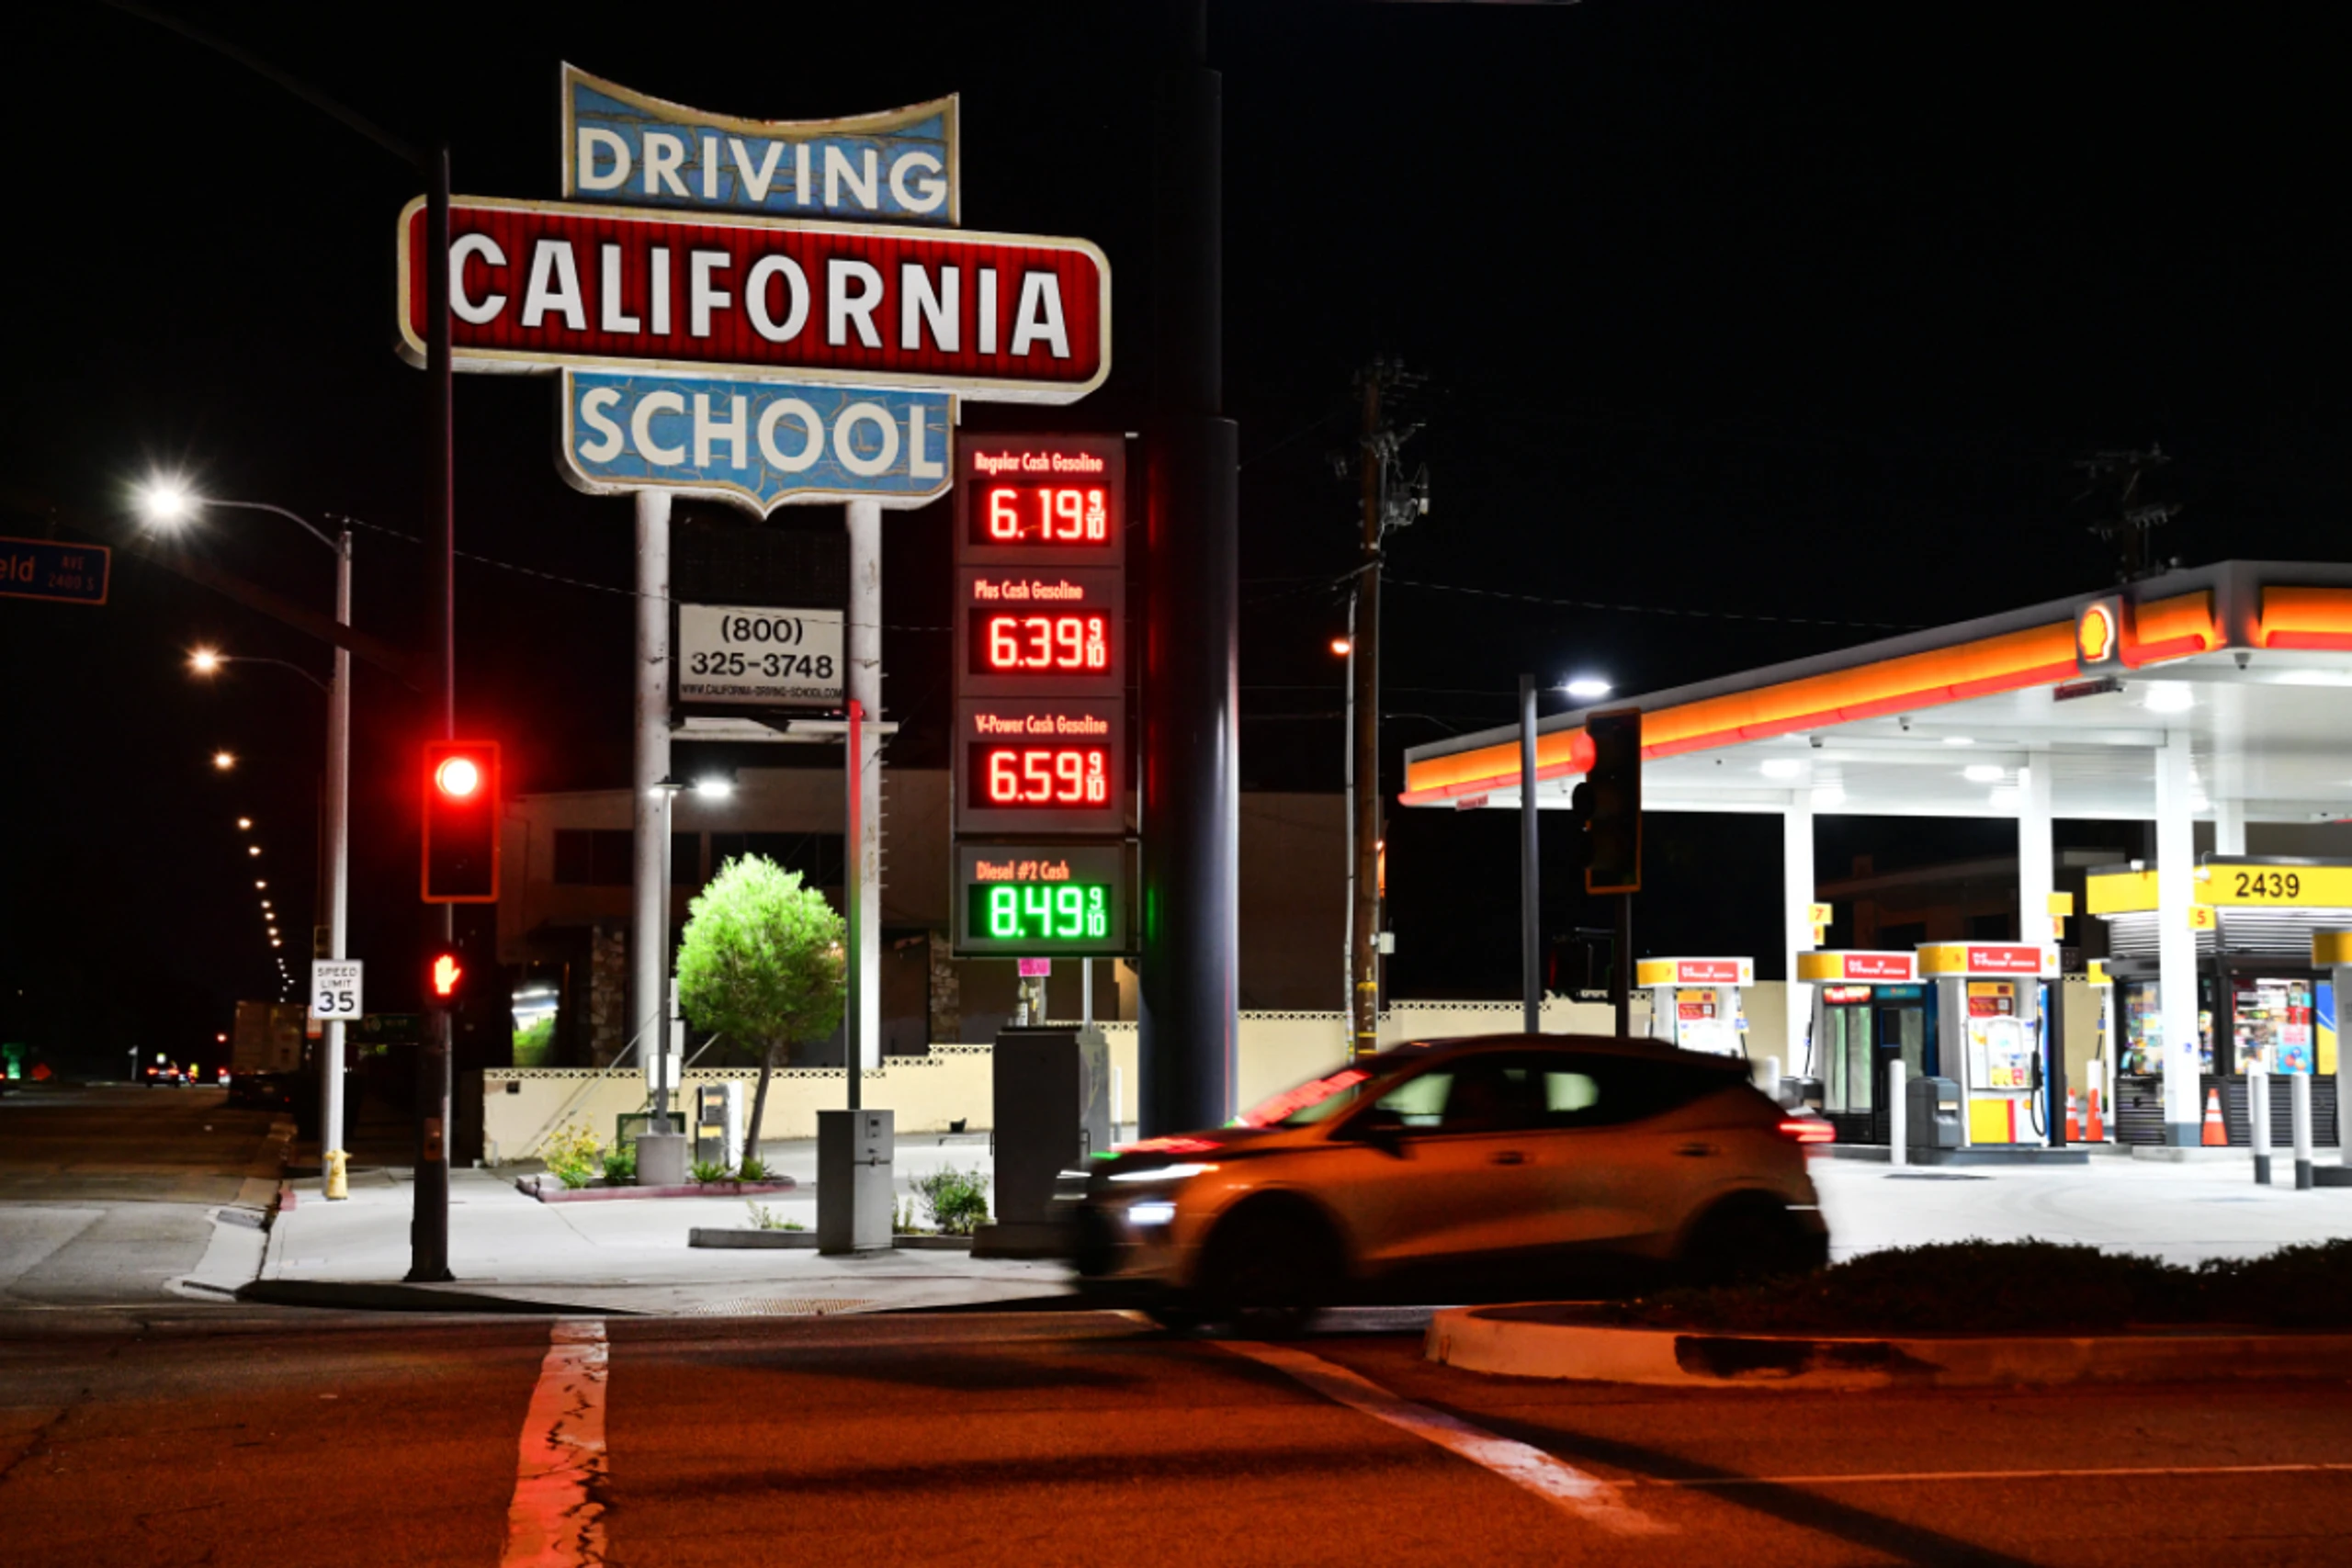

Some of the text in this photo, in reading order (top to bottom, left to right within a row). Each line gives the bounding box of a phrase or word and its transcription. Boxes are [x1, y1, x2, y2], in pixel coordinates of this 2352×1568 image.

[578, 127, 947, 213] DRIVING
[448, 232, 1070, 359] CALIFORNIA
[578, 386, 944, 479] SCHOOL
[974, 450, 1103, 476] Regular Cash Gasoline
[990, 489, 1082, 538] 6.19
[975, 580, 1084, 601] Plus Cash Gasoline
[721, 615, 803, 646] (800)
[990, 617, 1082, 667] 6.39
[691, 651, 834, 680] 325-3748
[975, 714, 1108, 734] V-Power Cash Gasoline
[990, 751, 1082, 801] 6.59
[977, 860, 1069, 880] Diesel #2 Cash
[2234, 873, 2301, 898] 2439
[991, 886, 1082, 936] 8.49
[1815, 908, 1825, 920] 7
[2197, 909, 2207, 925] 5
[317, 967, 358, 977] SPEED
[321, 979, 353, 989] LIMIT
[318, 990, 356, 1012] 35
